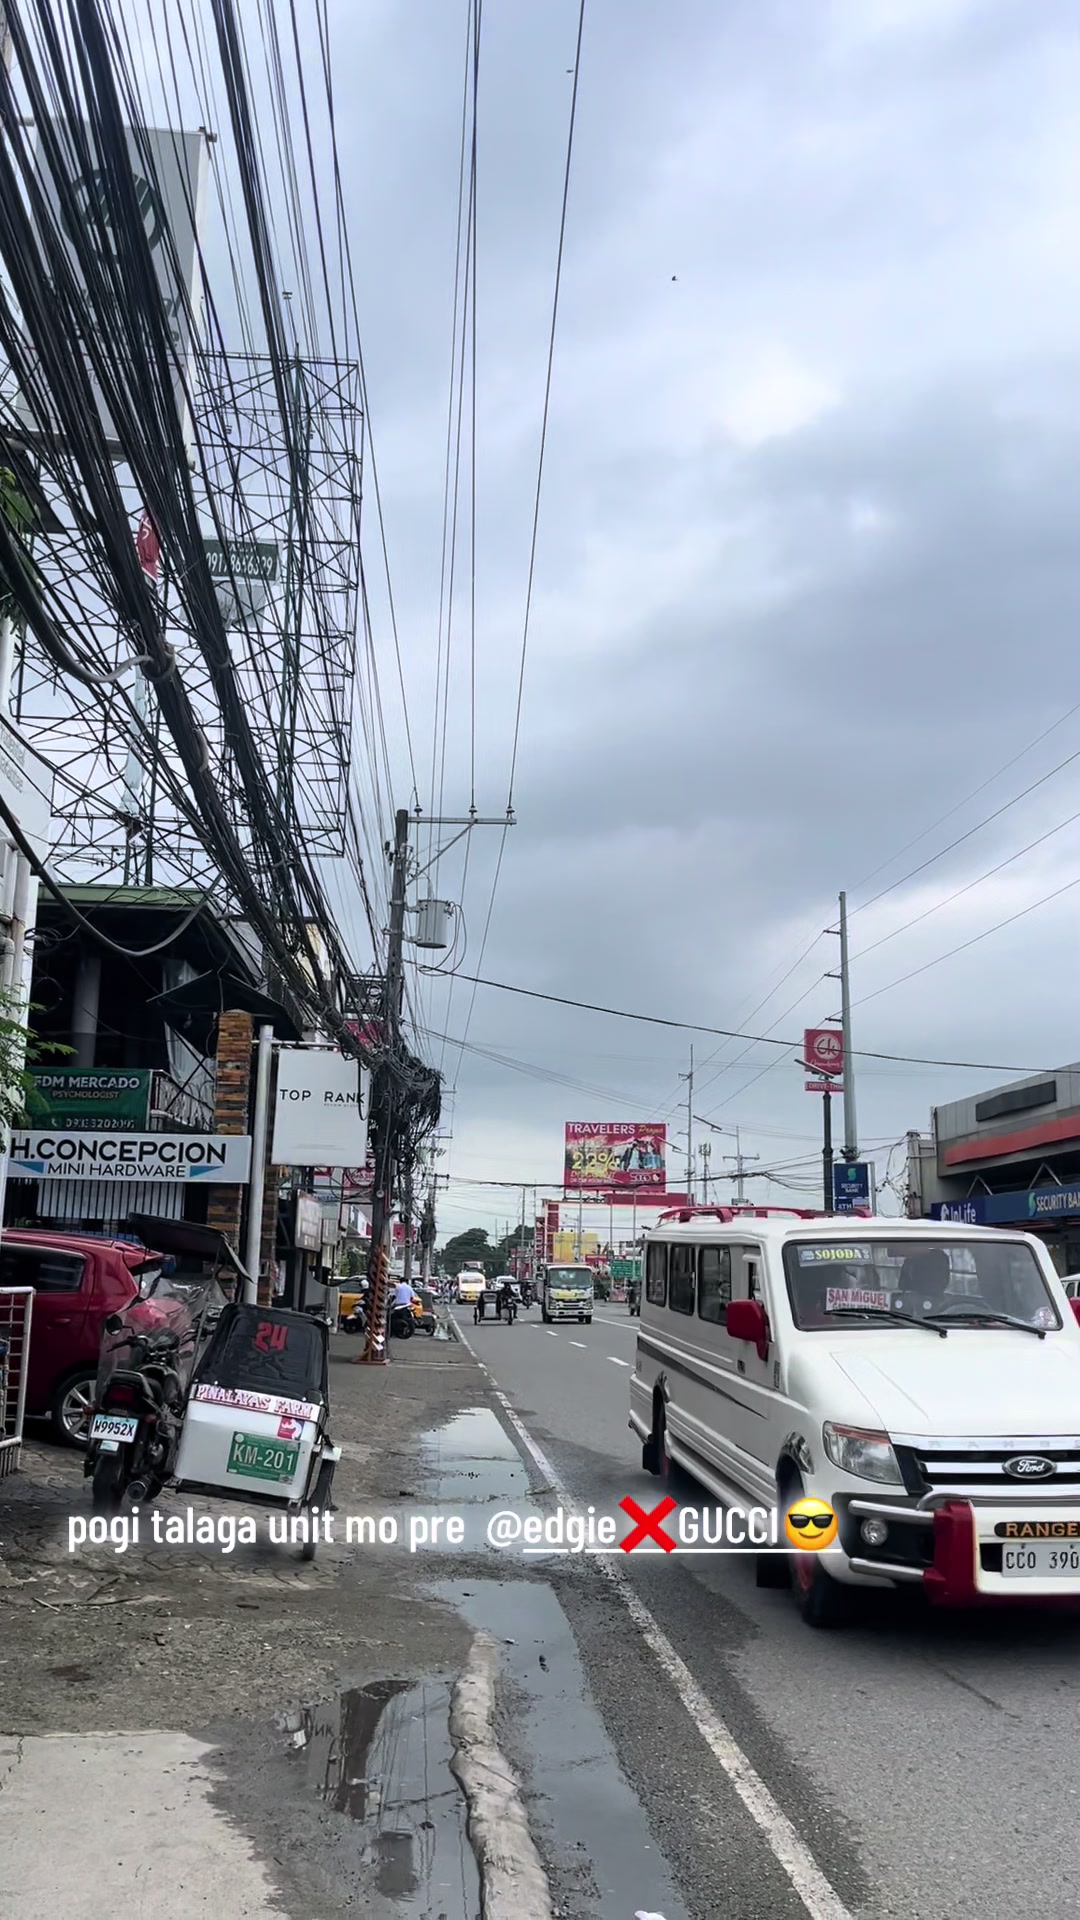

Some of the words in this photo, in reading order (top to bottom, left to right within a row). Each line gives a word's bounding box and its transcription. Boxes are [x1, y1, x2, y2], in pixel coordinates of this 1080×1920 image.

[69, 1077, 140, 1089] MERCADO
[52, 1090, 120, 1099] PSYCHOLOGIST
[280, 1089, 312, 1101] TOP
[324, 1091, 365, 1104] RANK
[568, 1123, 636, 1135] TRAVELERS
[10, 1138, 227, 1164] H.CONCEPCION
[47, 1162, 84, 1175] MINI
[89, 1163, 186, 1177] HARDWARE
[1036, 1193, 1067, 1211] SECURITY
[950, 1203, 977, 1224] InLife
[815, 1248, 862, 1260] SOJODA
[828, 1289, 848, 1303] SAN
[851, 1291, 888, 1307] MIGUEL
[255, 1322, 288, 1353] 24
[274, 1400, 313, 1418] FARM
[233, 1443, 294, 1471] KM-201
[1017, 1459, 1045, 1473] Ford
